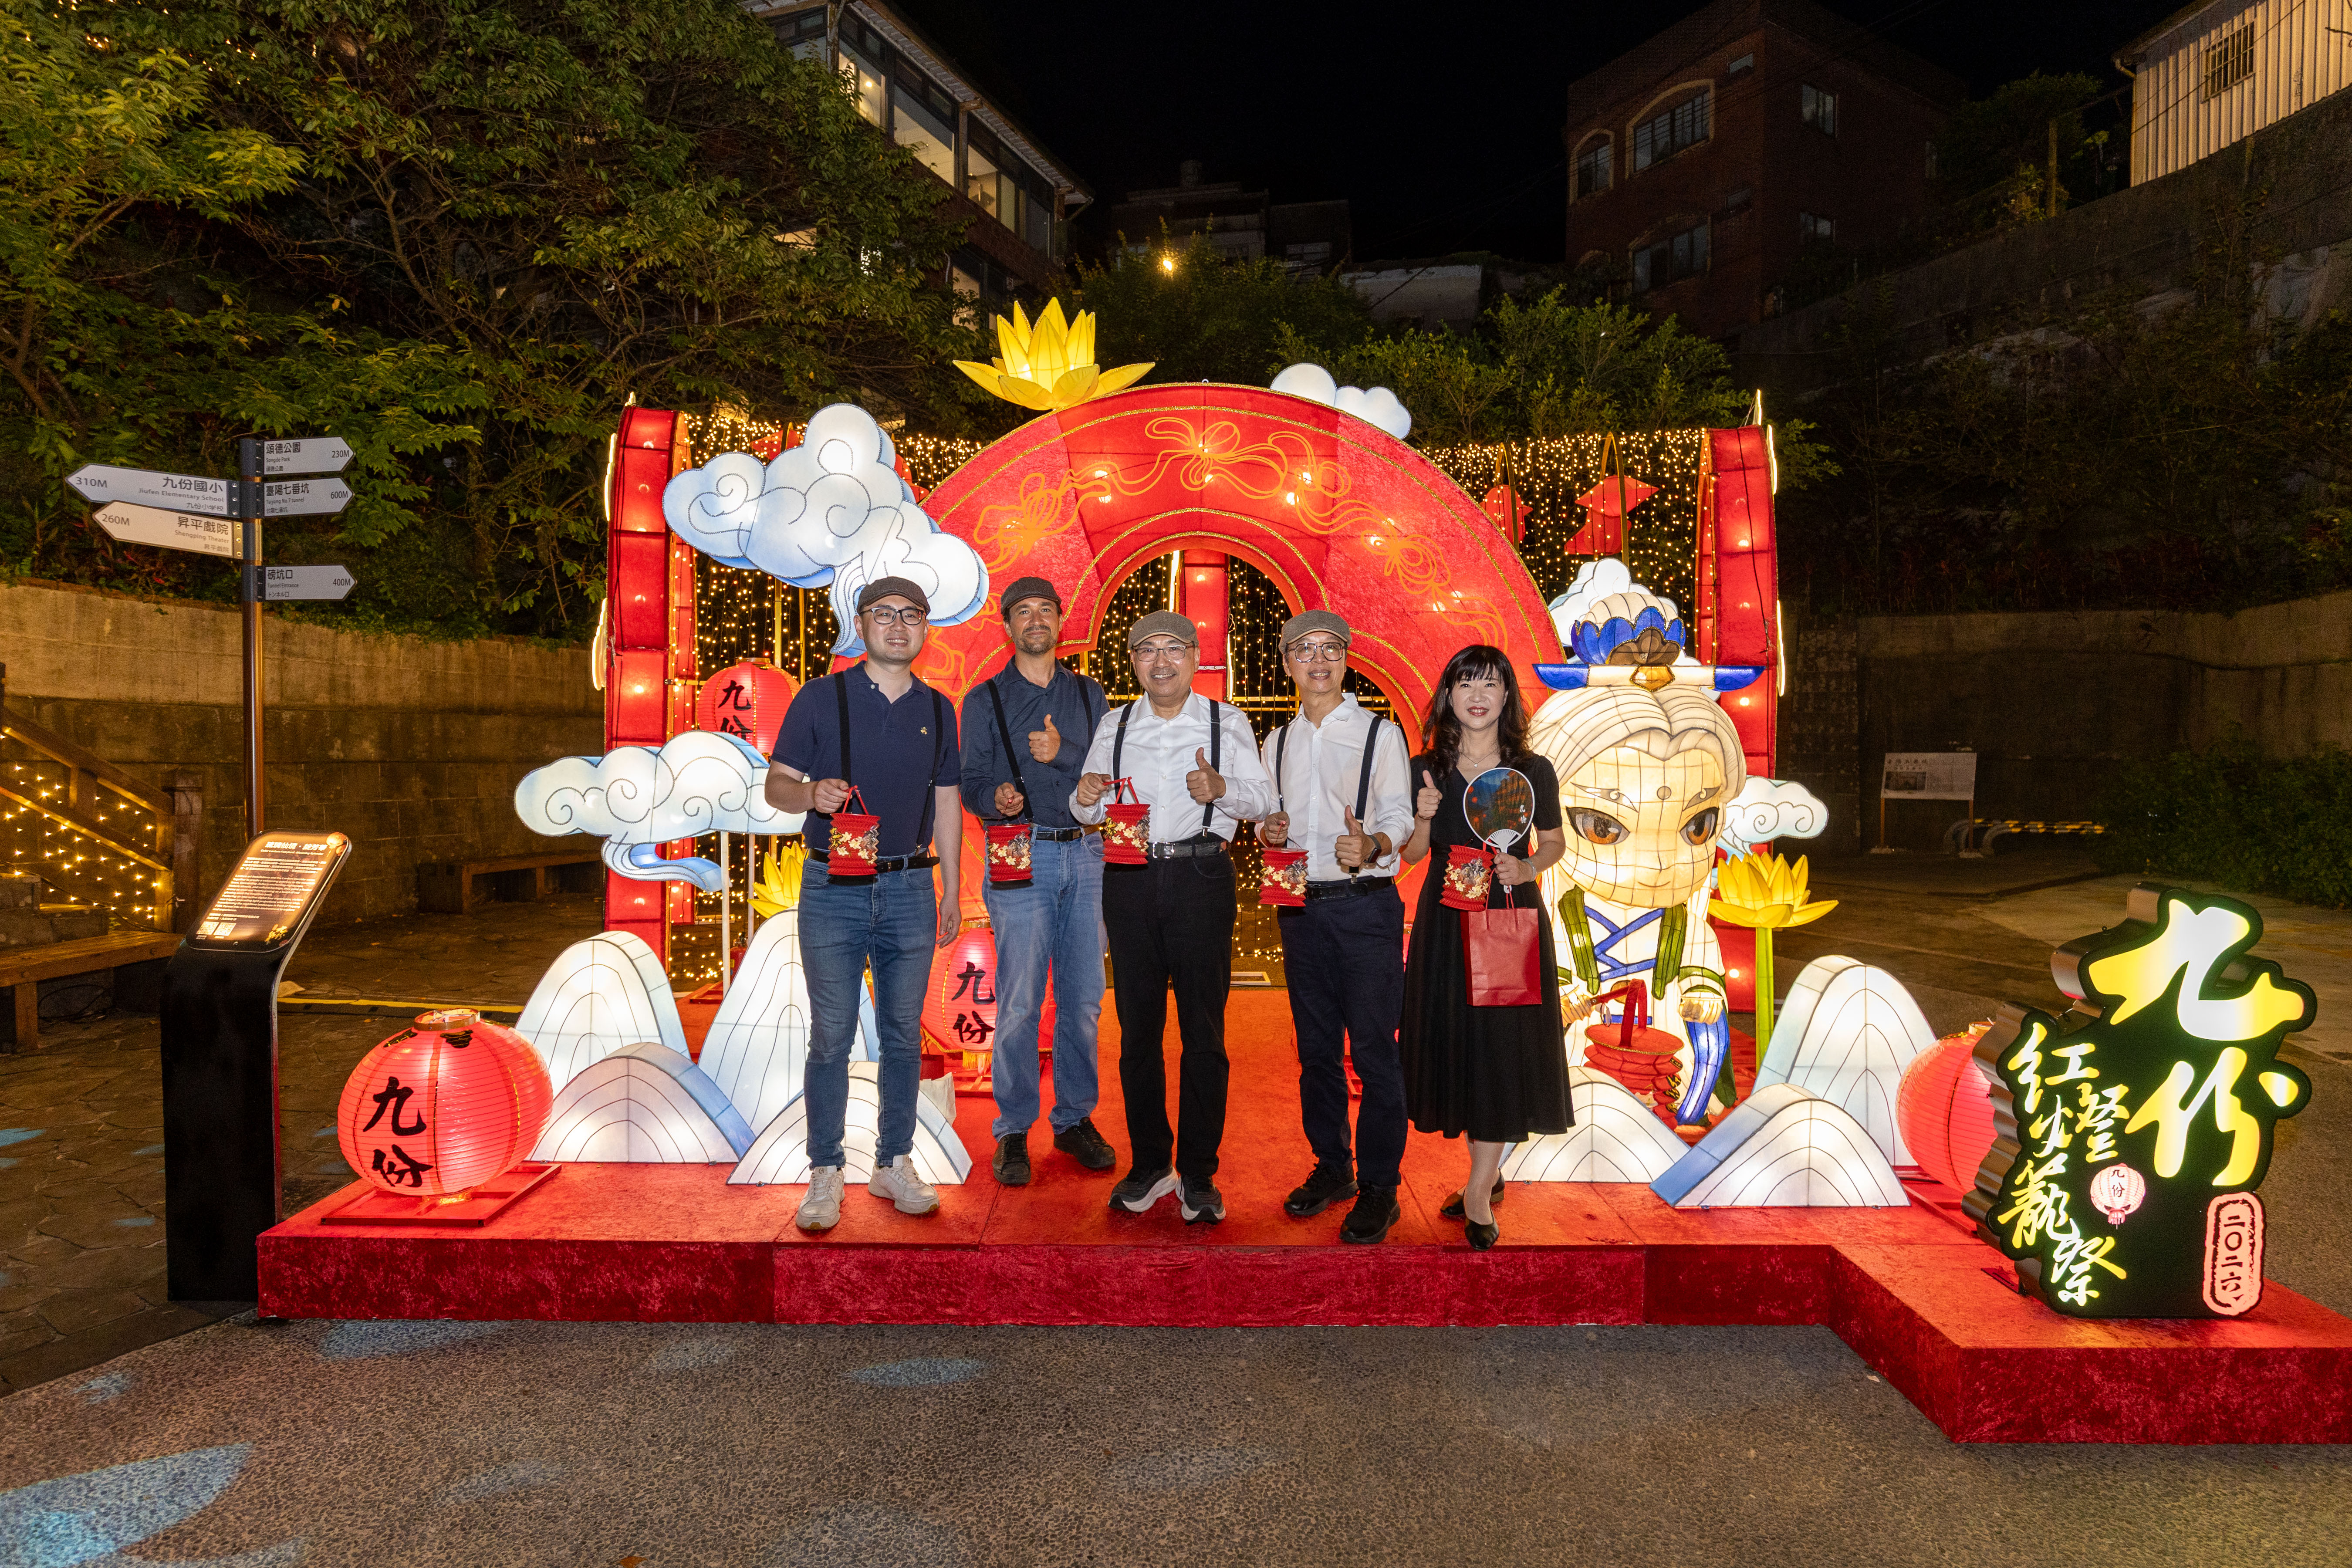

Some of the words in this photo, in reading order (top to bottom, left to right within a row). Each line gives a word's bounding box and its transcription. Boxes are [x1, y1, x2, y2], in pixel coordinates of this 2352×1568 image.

[266, 442, 301, 454] 頌德公園
[76, 477, 108, 488] 310M
[162, 476, 223, 493] 九份國小
[161, 490, 200, 501] Elementary
[266, 483, 309, 496] 臺陽七番坑
[331, 491, 348, 499] 600M
[102, 514, 130, 526] 260M
[178, 516, 229, 535] 昇平戲院
[175, 530, 206, 541] Shengping
[208, 535, 229, 543] Theater
[267, 569, 293, 580] 磅坑口
[951, 961, 996, 1044] 九份
[2088, 899, 2304, 1186] 九份
[362, 1076, 434, 1187] 九份
[2111, 1169, 2126, 1197] 九份
